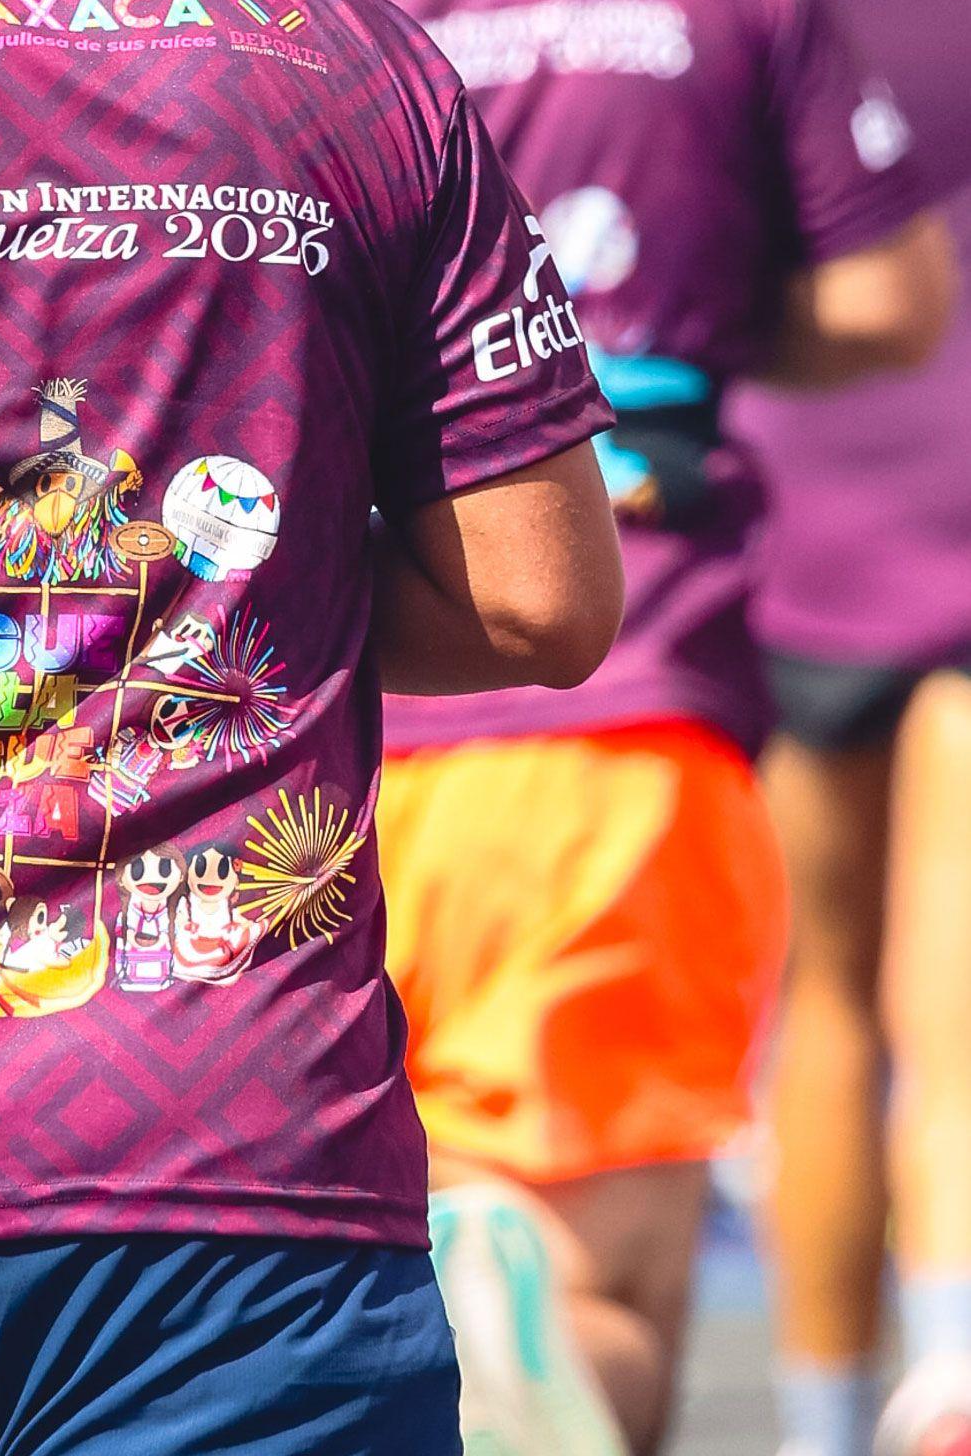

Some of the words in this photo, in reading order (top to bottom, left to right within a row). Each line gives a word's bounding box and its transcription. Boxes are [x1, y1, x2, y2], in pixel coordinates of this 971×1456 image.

[74, 39, 102, 53] de
[106, 39, 146, 52] sus
[150, 34, 217, 50] raíces
[229, 30, 328, 67] DEPORTE
[231, 44, 275, 56] INSTITUTO
[291, 57, 328, 75] DEPORTE
[35, 181, 334, 228] INTERNACIONAL
[162, 210, 330, 277] 2026
